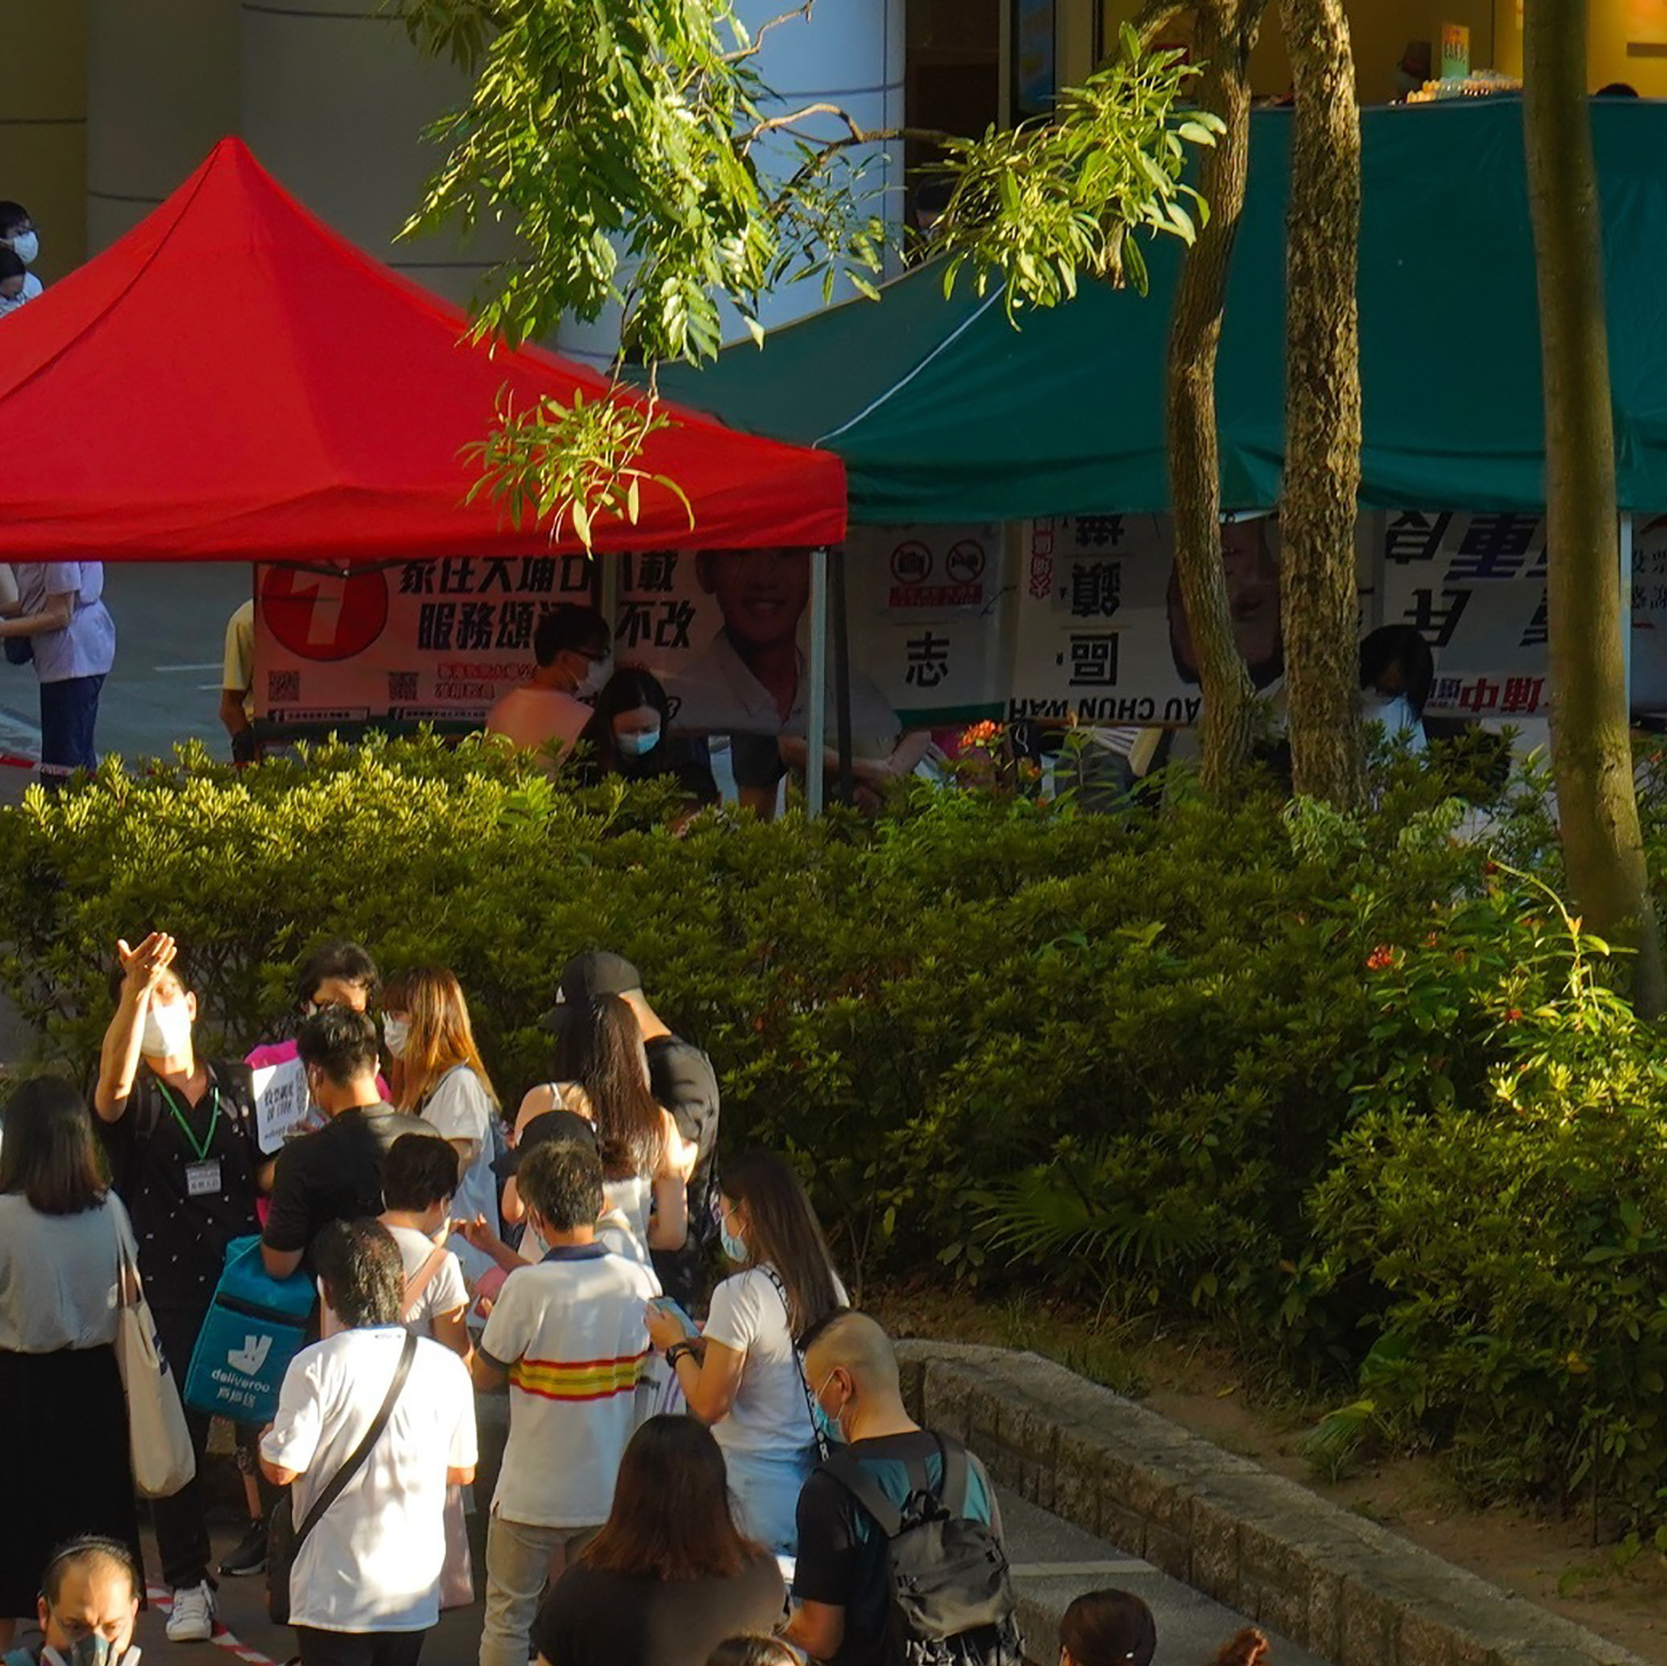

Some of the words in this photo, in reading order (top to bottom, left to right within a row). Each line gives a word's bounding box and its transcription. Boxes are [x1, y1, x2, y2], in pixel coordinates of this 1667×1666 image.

[904, 630, 950, 688] 志
[1009, 696, 1068, 722] WAH
[1078, 696, 1156, 721] CHUN
[1163, 696, 1202, 722] AU
[211, 1368, 271, 1393] deliveroo
